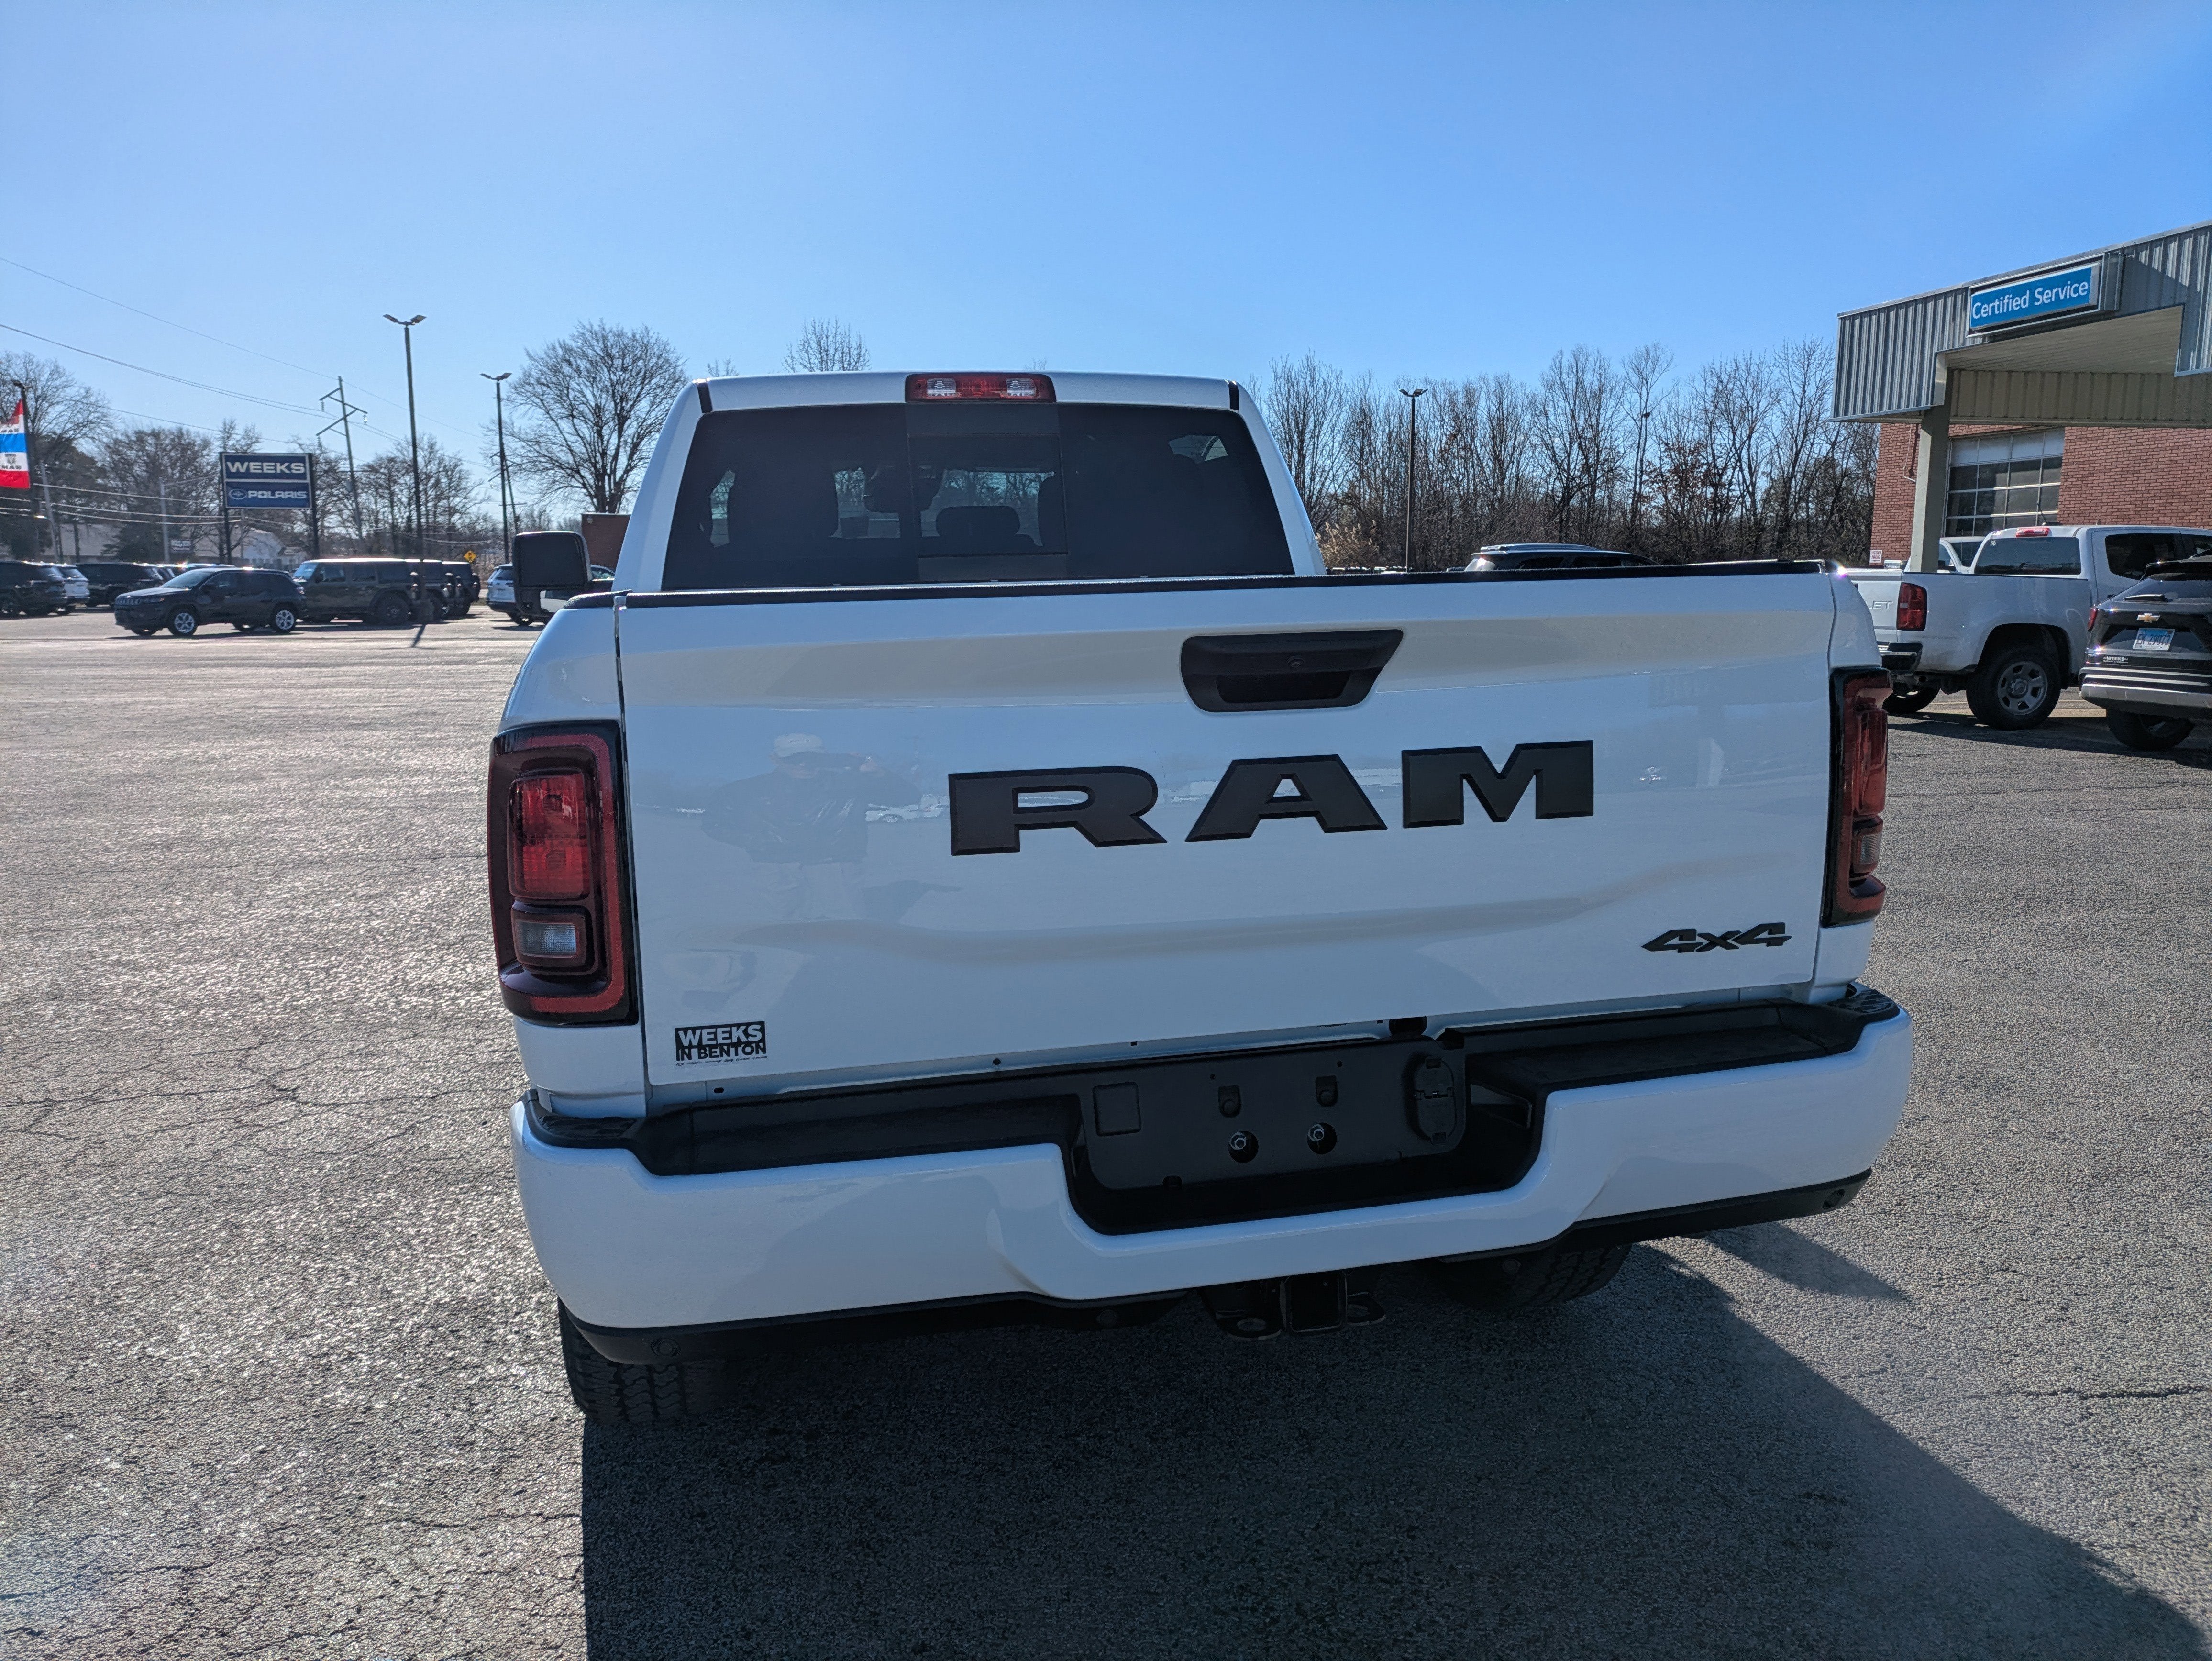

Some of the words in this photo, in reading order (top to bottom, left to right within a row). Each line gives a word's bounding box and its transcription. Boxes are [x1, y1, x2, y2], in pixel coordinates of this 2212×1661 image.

[1972, 289, 2030, 319] Certified
[2034, 281, 2089, 306] Service
[226, 462, 305, 474] WEEKS
[248, 490, 307, 499] POLARIS
[949, 740, 1593, 856] RAM
[1641, 922, 1792, 953] 4x4
[678, 1024, 762, 1047] WEEKS
[676, 1048, 692, 1061] IN
[697, 1042, 766, 1060] BENTON
